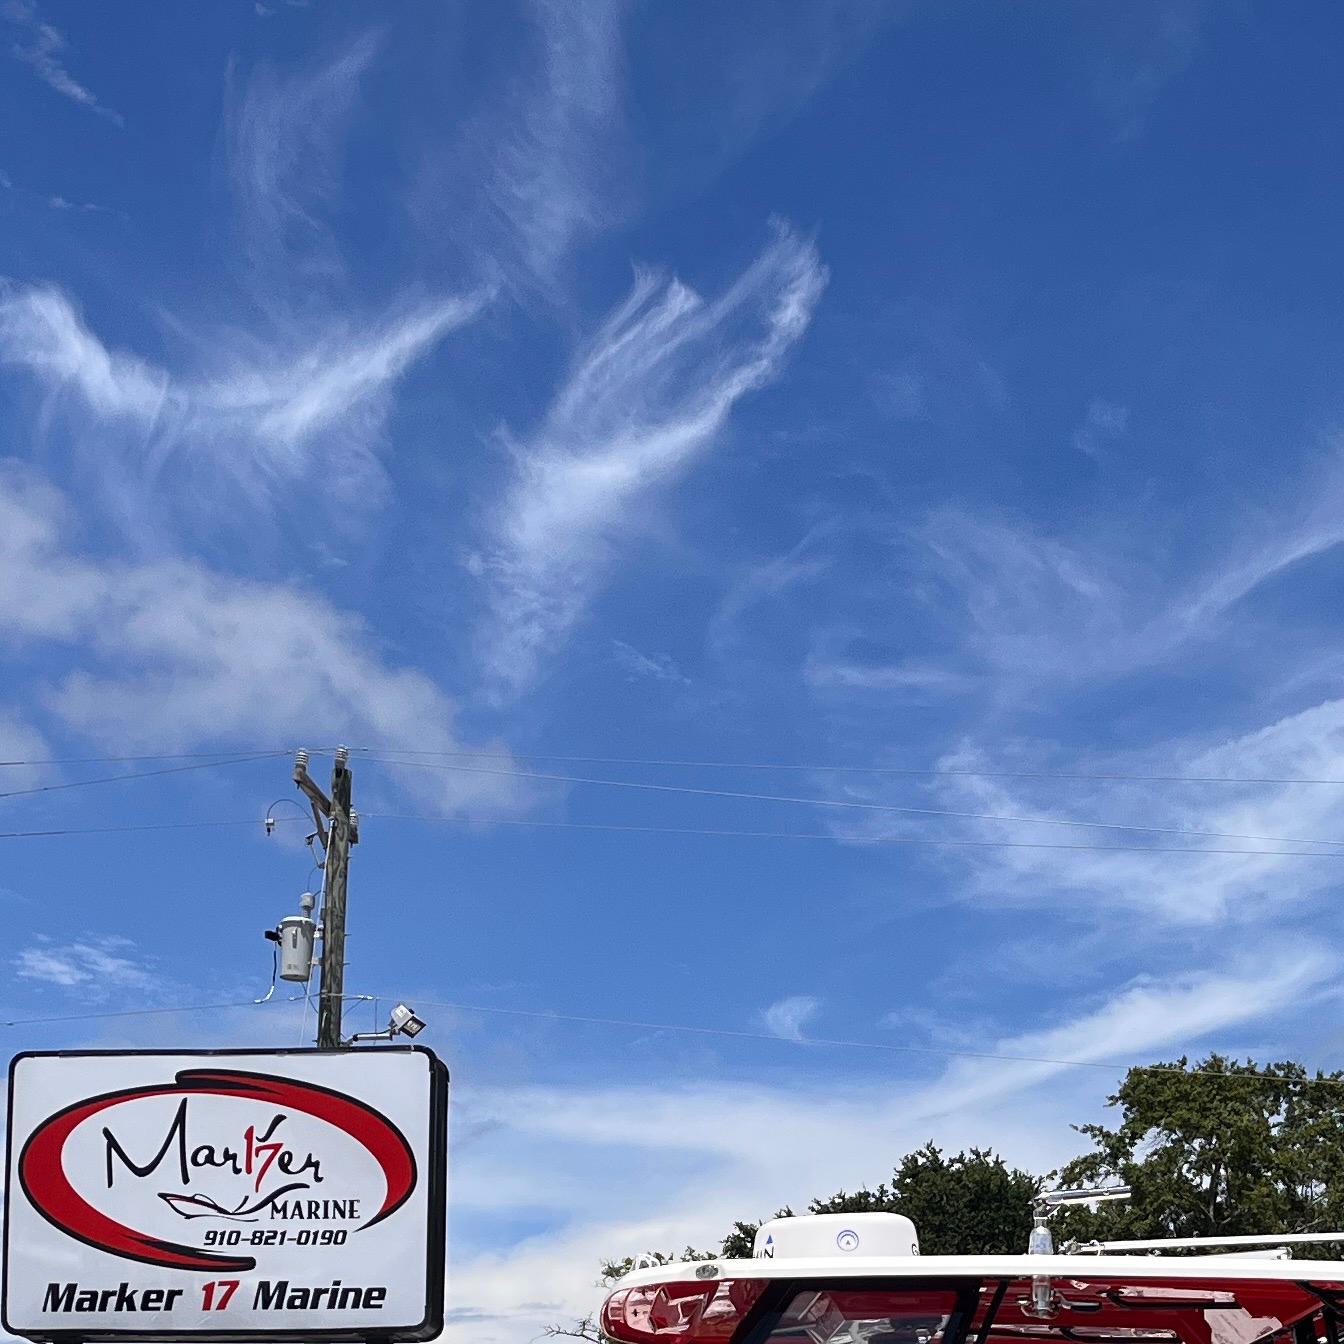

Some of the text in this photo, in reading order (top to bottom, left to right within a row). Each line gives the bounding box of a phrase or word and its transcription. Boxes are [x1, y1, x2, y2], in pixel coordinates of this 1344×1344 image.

[269, 1198, 361, 1221] MARINE
[203, 1229, 348, 1247] 910-821-0190
[42, 1279, 388, 1313] Marker 17 Marine
